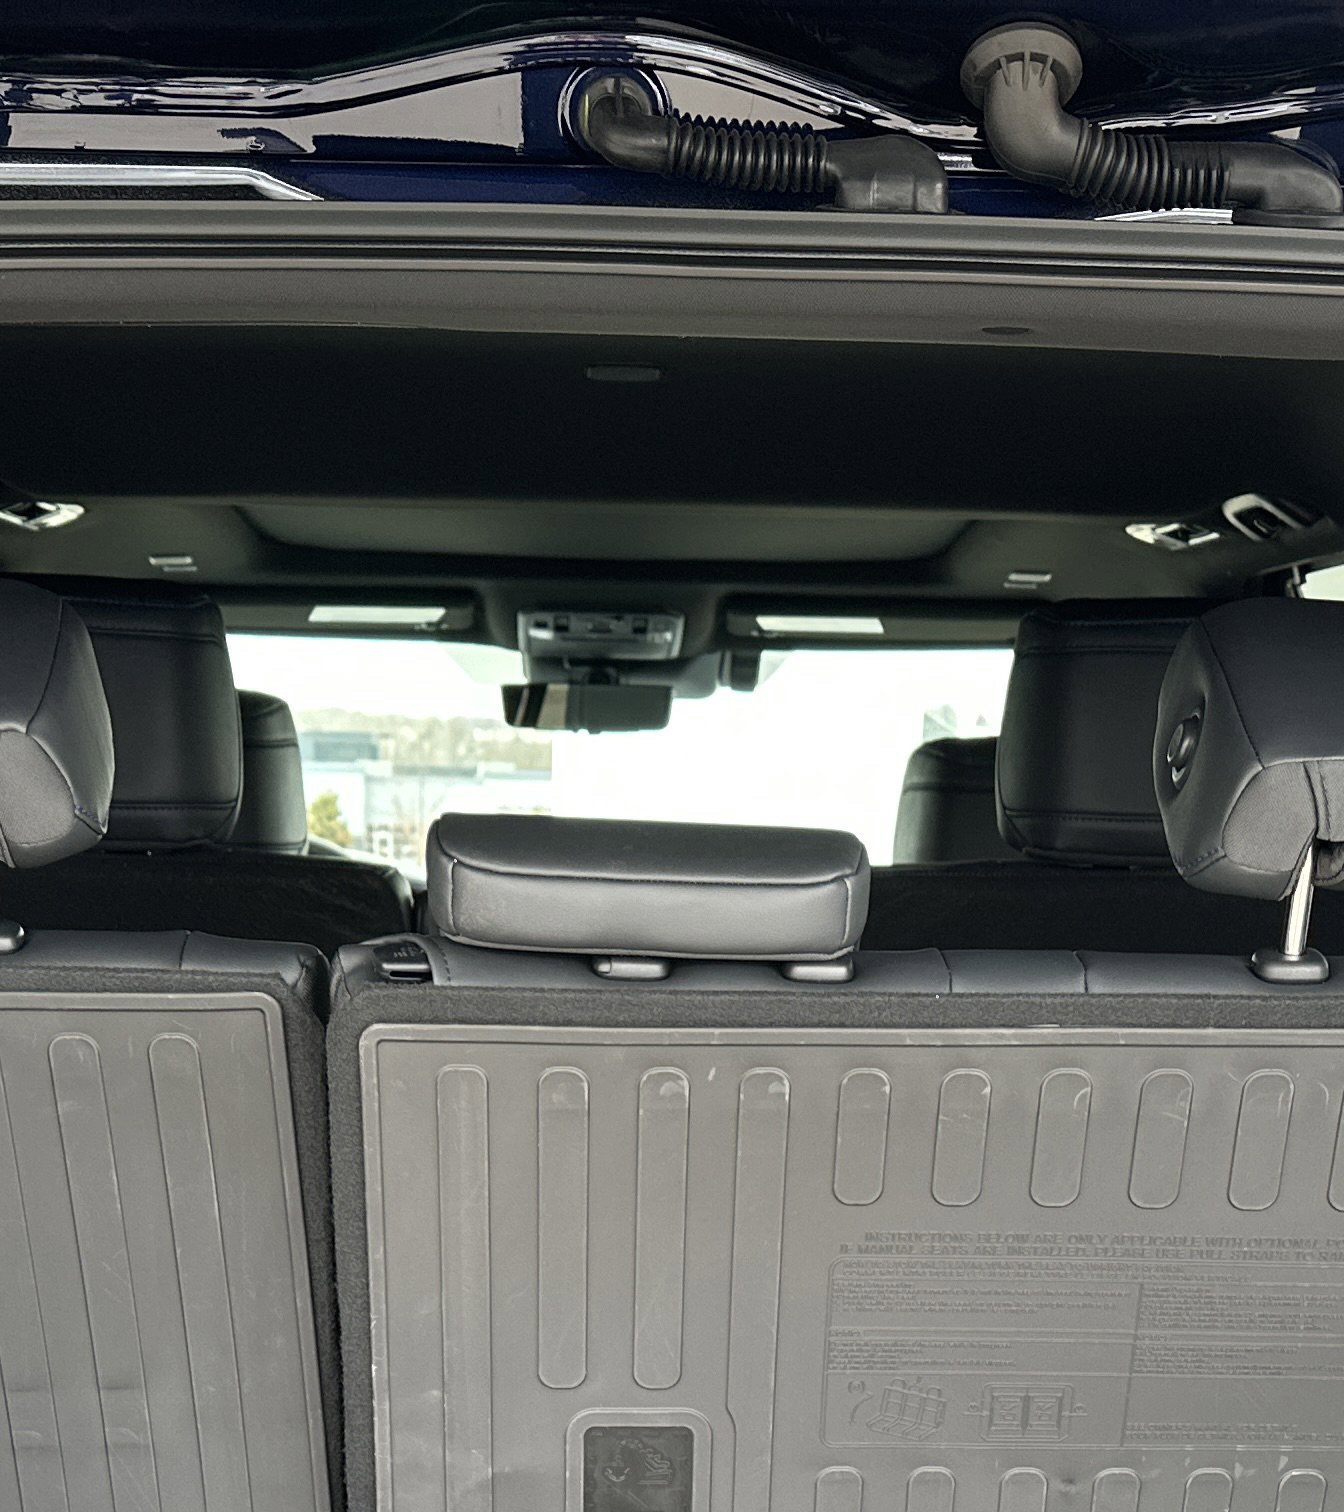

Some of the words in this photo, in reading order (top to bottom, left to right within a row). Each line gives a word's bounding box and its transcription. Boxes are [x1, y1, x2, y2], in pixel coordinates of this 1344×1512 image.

[864, 1231, 974, 1243] INSTRUCTIONS
[976, 1232, 1030, 1244] BELOW
[1033, 1233, 1063, 1245] ARE
[1067, 1233, 1108, 1245] ONLY
[1110, 1234, 1202, 1247] APPLICABLE
[1205, 1236, 1244, 1248] WITH
[1246, 1237, 1322, 1249] OPTIONAL
[857, 1244, 917, 1255] MANUAL
[921, 1244, 969, 1255] SEATS
[973, 1245, 1003, 1256] ARE
[1093, 1247, 1152, 1258] PLEASE
[1155, 1248, 1186, 1259] USE
[1189, 1248, 1227, 1260] PULL
[1294, 1250, 1314, 1261] TO
